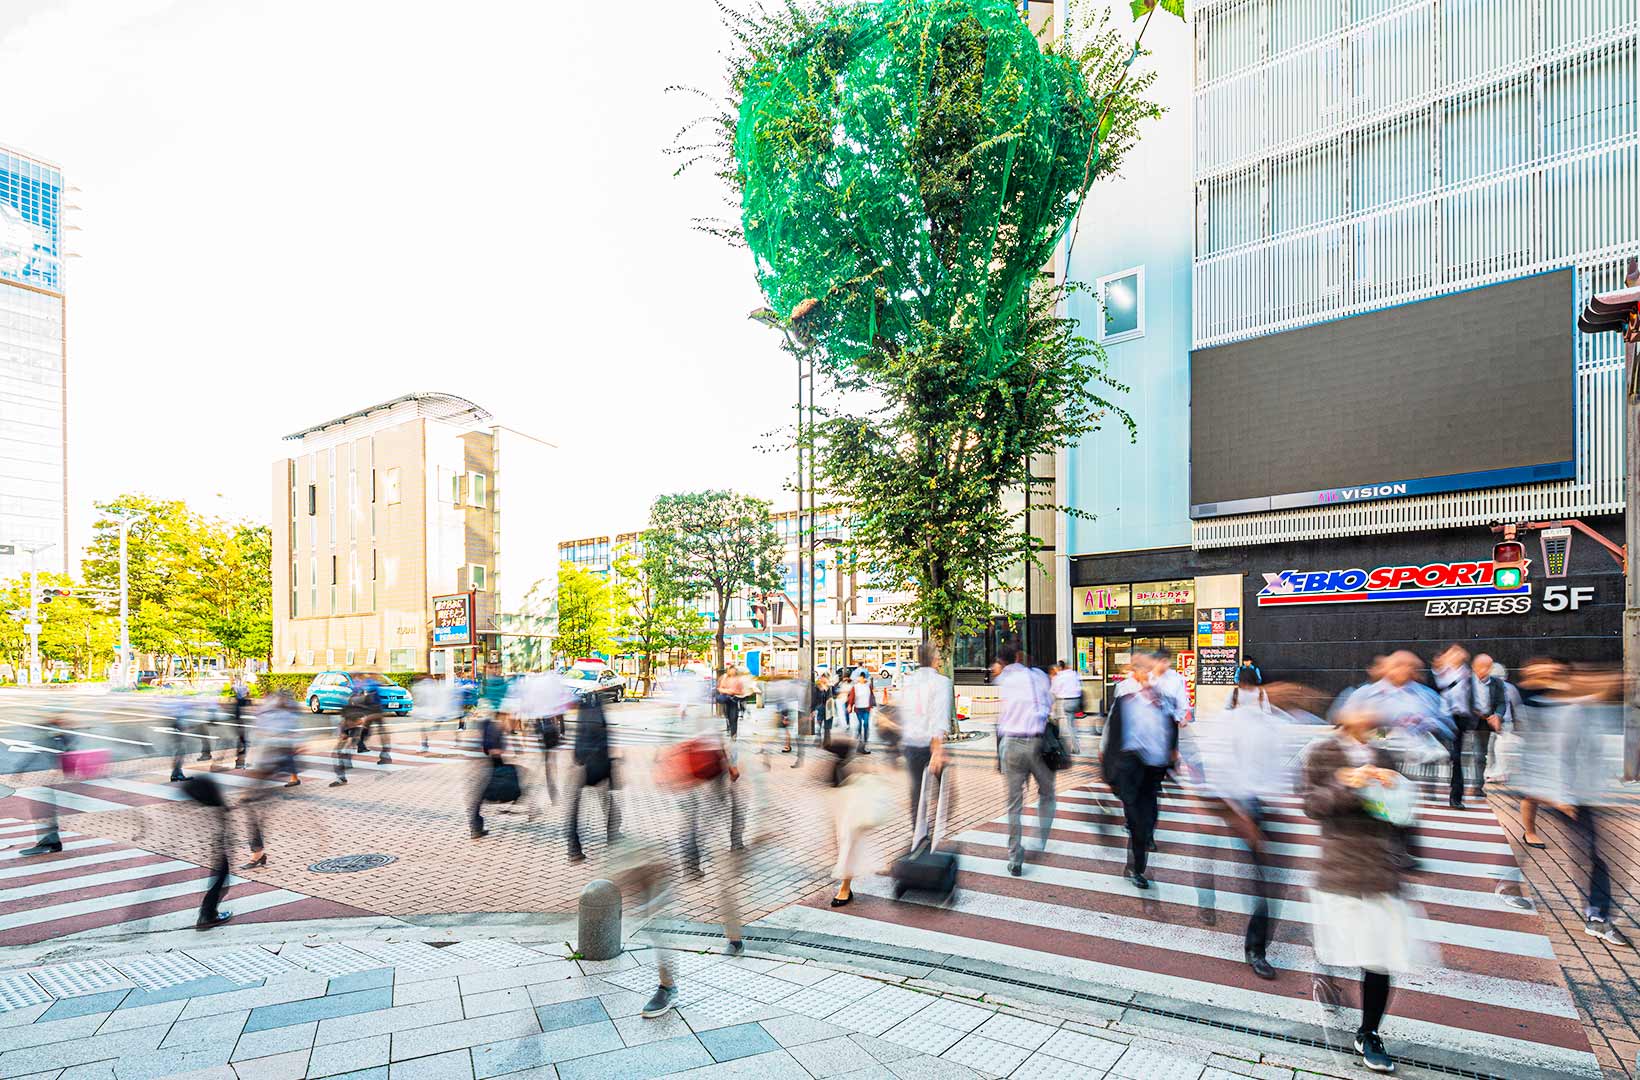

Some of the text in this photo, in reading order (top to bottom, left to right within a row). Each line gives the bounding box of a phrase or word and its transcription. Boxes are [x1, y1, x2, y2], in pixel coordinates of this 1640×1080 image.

[1341, 484, 1406, 500] VISION
[1256, 569, 1368, 595] XEBIO
[1136, 590, 1190, 600] ヨドバシカメラ
[1542, 586, 1595, 611] 5F
[1425, 599, 1531, 616] EXPRESS
